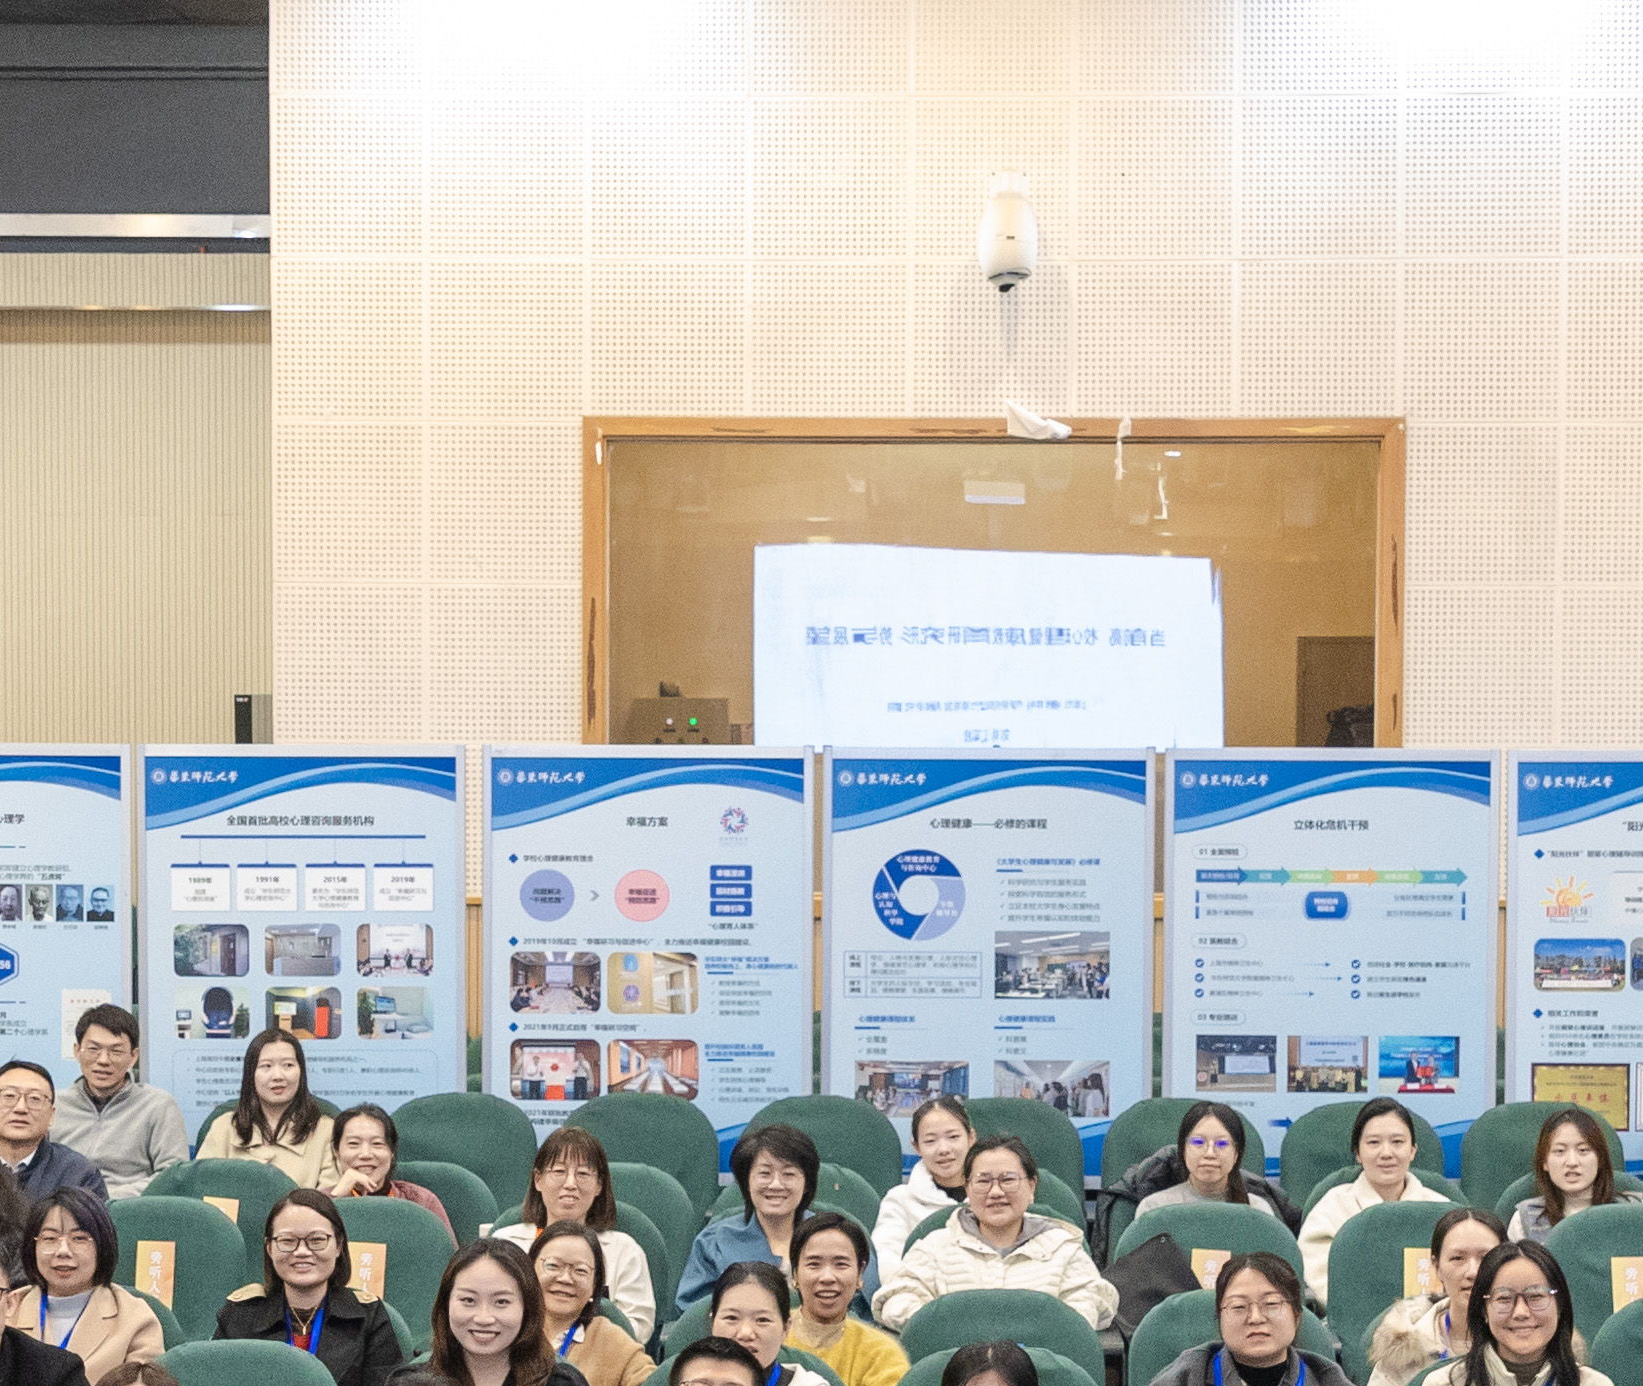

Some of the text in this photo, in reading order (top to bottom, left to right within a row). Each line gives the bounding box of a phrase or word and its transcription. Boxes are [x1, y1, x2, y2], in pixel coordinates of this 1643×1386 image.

[226, 815, 374, 826] 全国首批高校心理咨询服务机构
[626, 816, 668, 828] 幸福方案
[930, 818, 1048, 830] 心理健康——必修的课程
[1293, 819, 1369, 831] 立体化危机干预
[149, 1251, 163, 1297] 旁听人
[1624, 1266, 1639, 1303] 旁听
